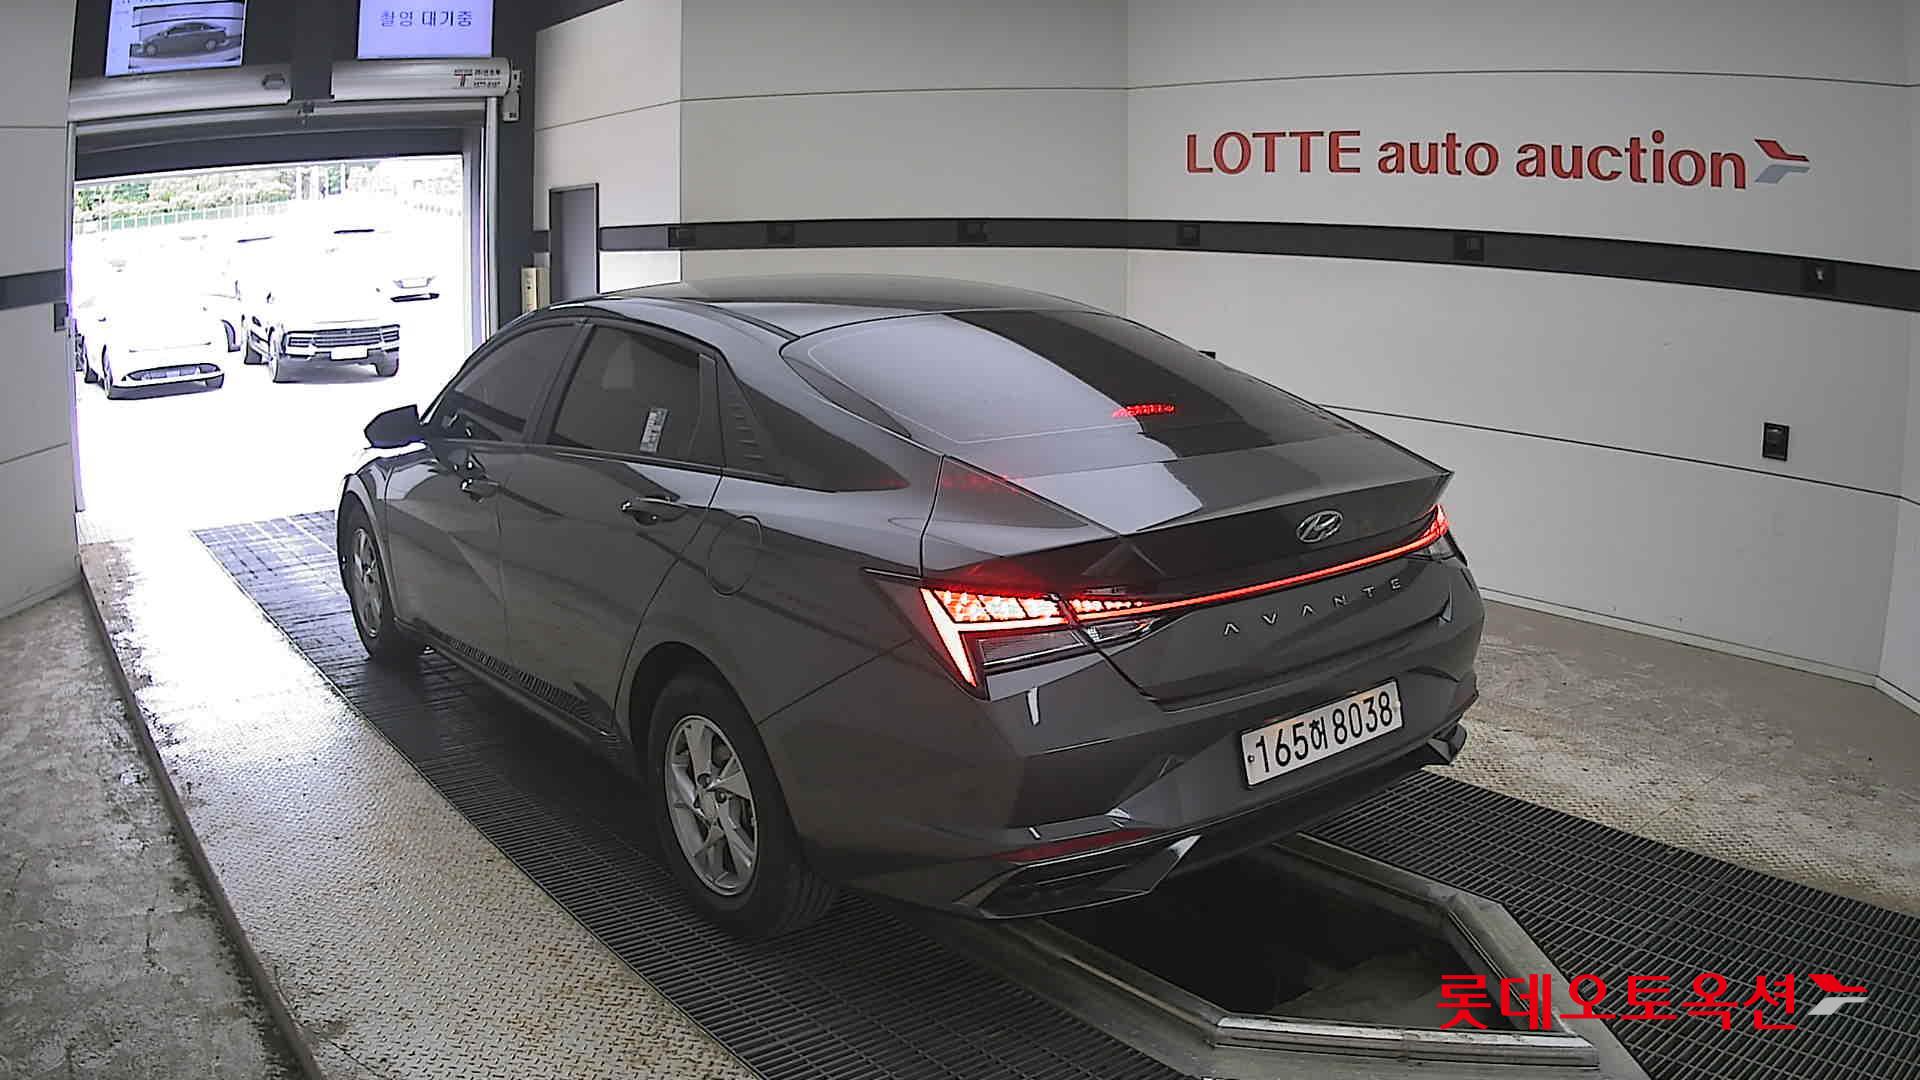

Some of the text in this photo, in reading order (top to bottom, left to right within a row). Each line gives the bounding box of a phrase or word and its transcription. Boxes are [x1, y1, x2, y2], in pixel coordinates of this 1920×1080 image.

[422, 10, 472, 27] 대기중
[1186, 130, 1747, 190] LOTTE auto auction
[1223, 577, 1402, 636] AVANTE
